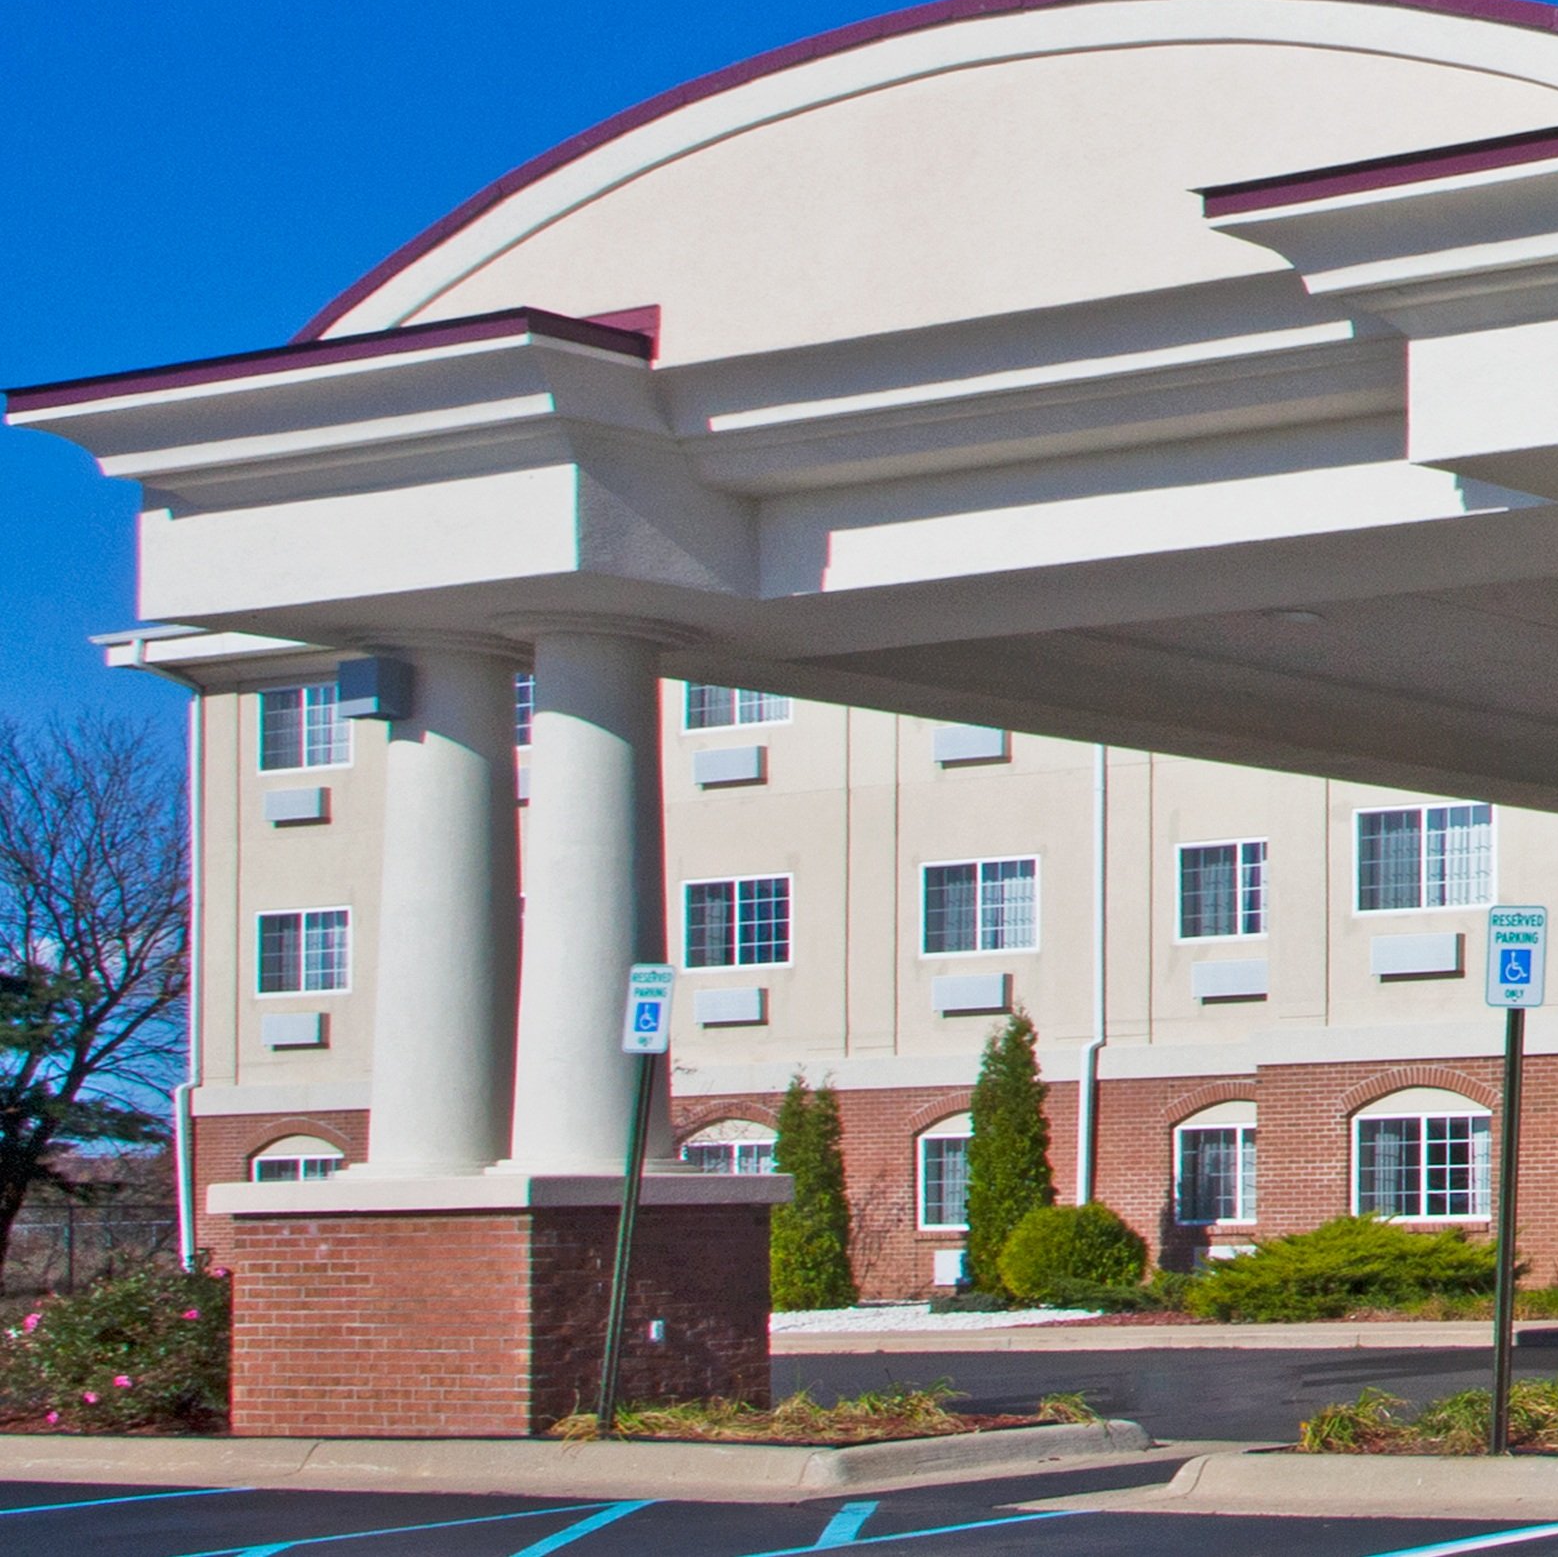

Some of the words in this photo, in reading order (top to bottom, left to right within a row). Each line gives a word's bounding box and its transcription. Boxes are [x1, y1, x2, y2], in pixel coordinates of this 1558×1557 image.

[1492, 914, 1544, 927] RESERVED
[1495, 931, 1539, 944] PARKING
[1505, 989, 1525, 999] ONLY
